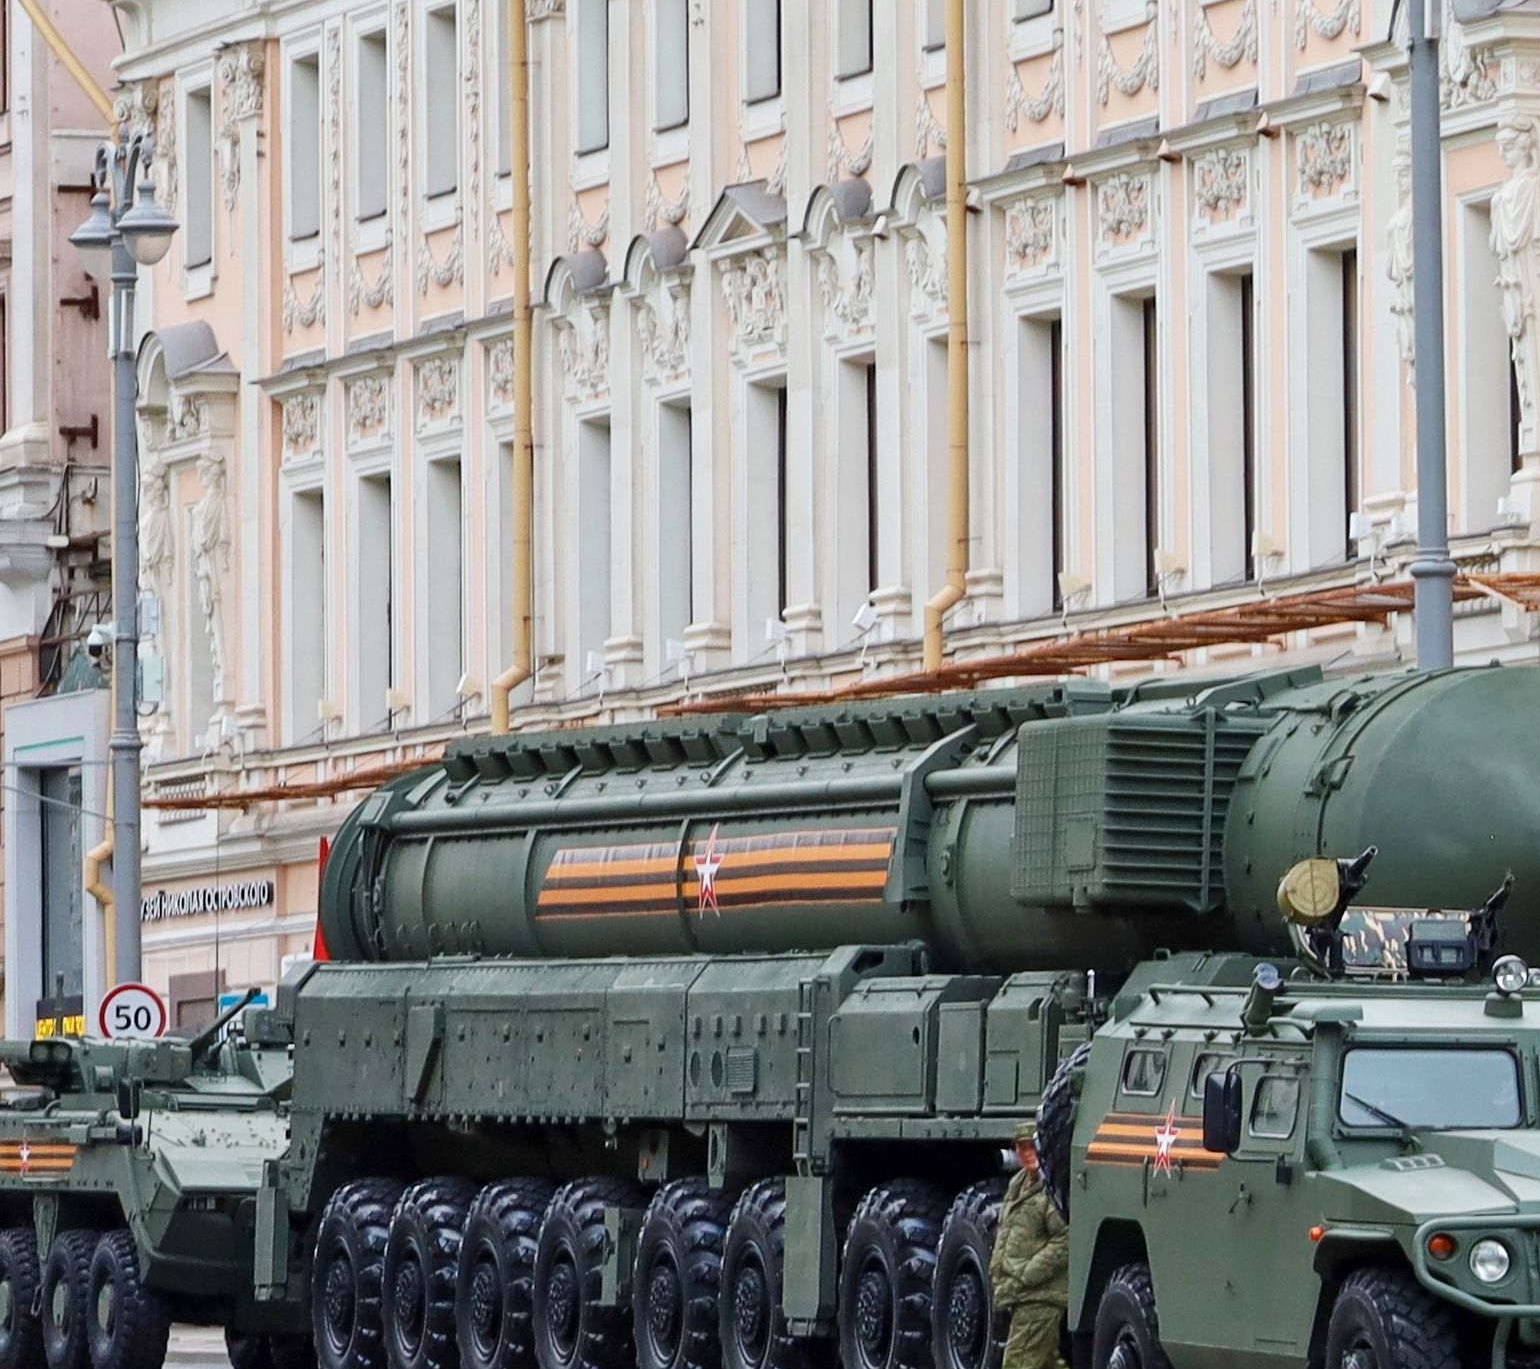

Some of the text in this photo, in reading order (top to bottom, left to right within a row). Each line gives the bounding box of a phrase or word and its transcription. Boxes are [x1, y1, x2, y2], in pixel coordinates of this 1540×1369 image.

[161, 891, 204, 919] НИКОЛАЯ
[205, 880, 269, 912] ОСТРОВСКОГО
[114, 1005, 151, 1031] 50
